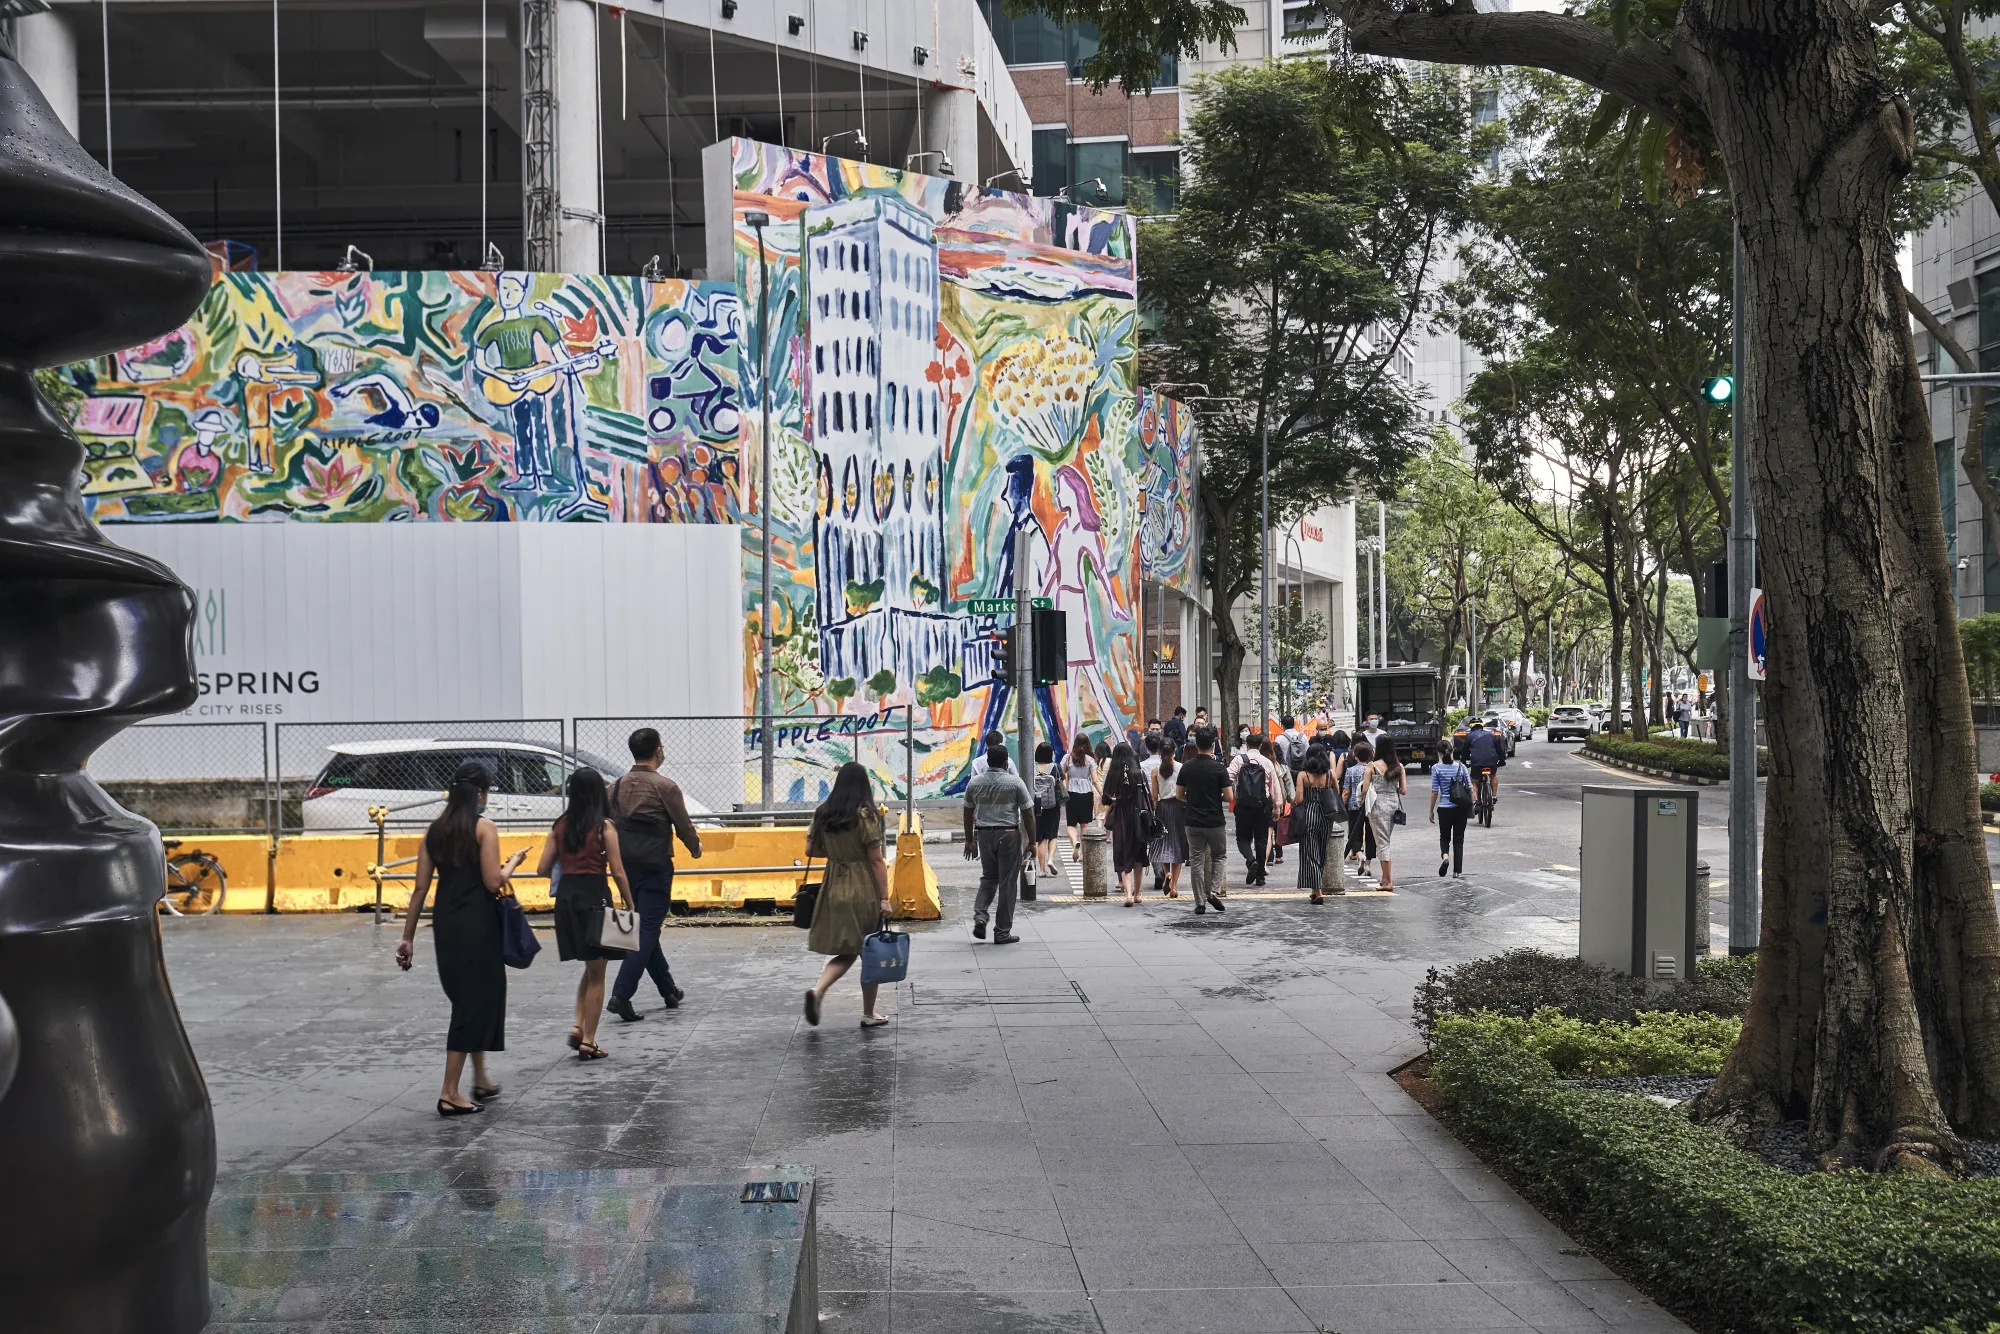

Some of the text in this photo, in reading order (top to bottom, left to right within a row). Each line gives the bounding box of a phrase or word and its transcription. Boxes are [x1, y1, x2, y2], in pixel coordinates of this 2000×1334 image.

[320, 427, 431, 449] RIPPLE ROOT
[974, 600, 1045, 612] Marke St
[198, 671, 319, 695] SPRING
[199, 705, 233, 716] CITY
[240, 704, 283, 715] RISES
[751, 705, 905, 750] RPPLE ROOT
